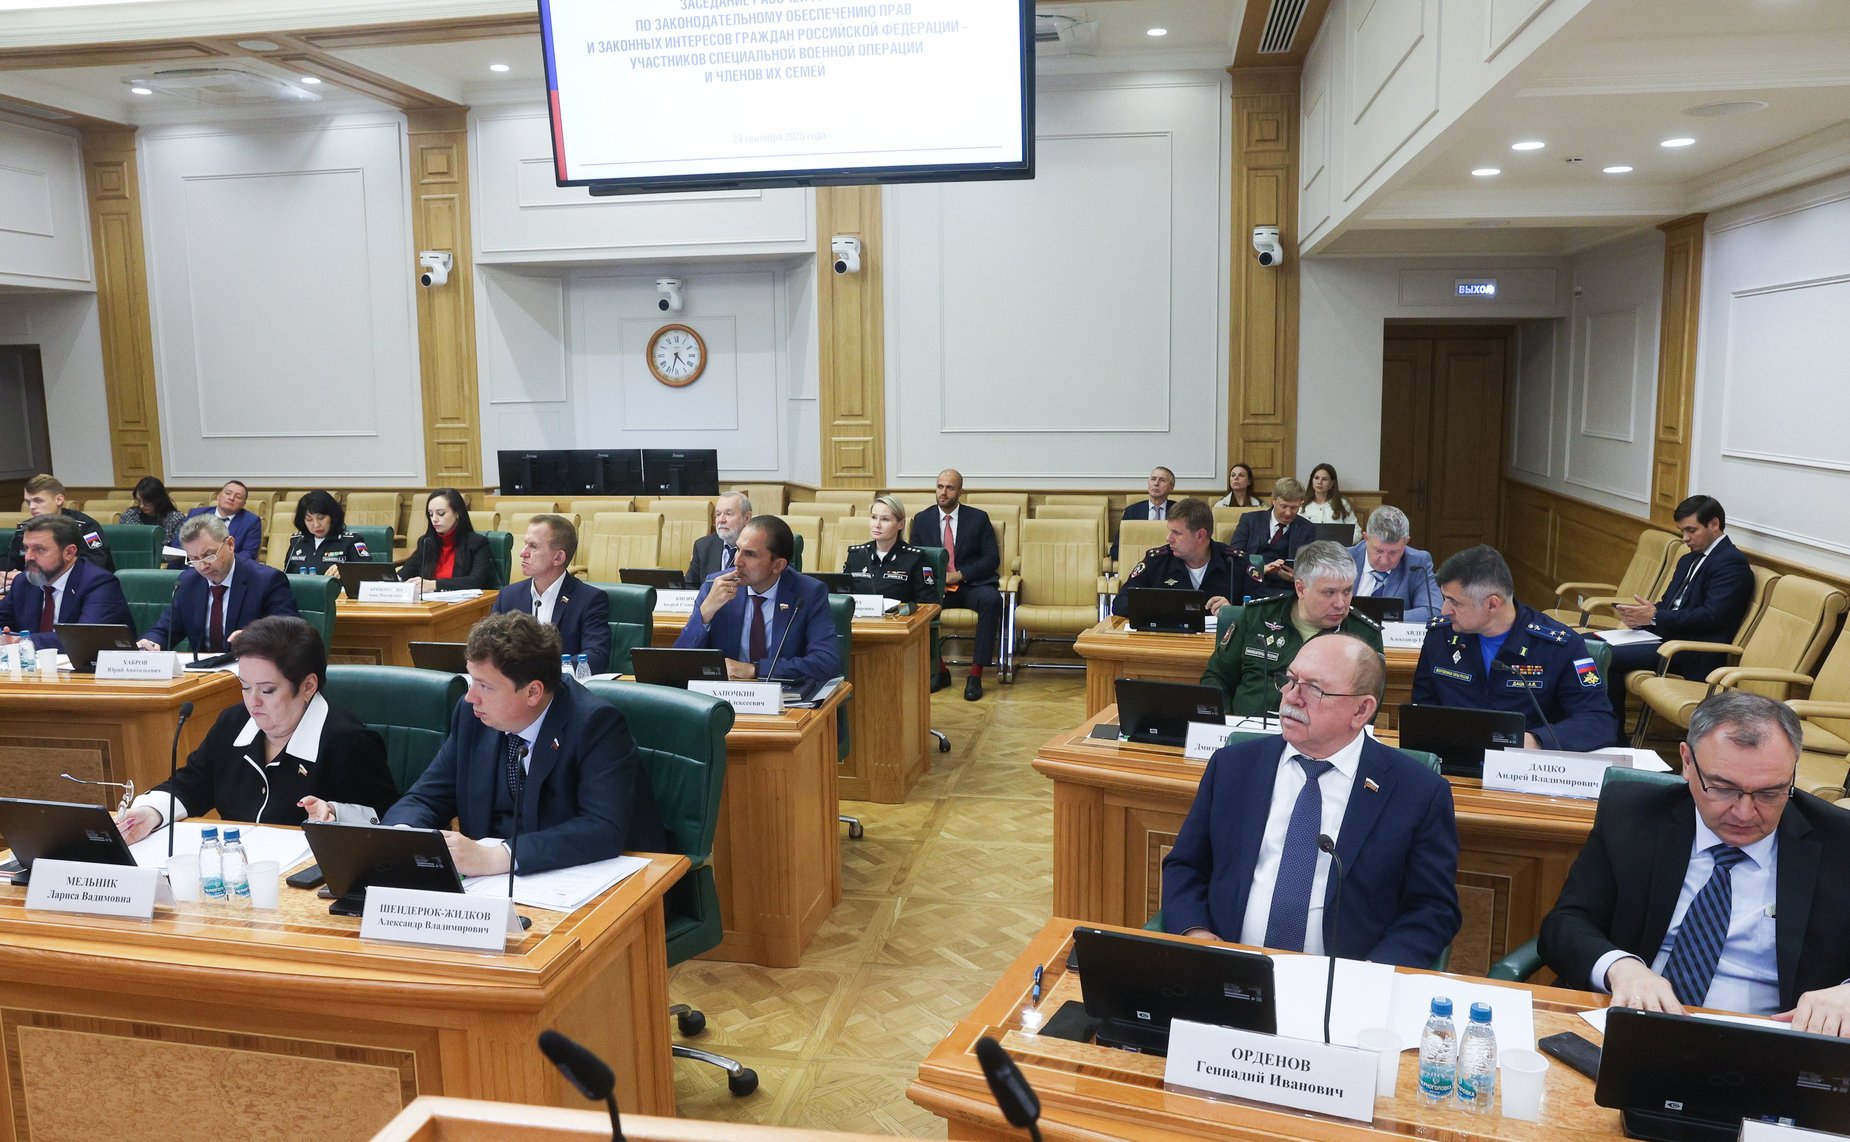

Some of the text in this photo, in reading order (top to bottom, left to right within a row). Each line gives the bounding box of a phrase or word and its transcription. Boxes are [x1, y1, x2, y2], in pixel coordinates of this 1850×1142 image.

[635, 4, 912, 32] ПО ЗАКОНОДАТЕЛЬНОМУ ОБЕСПЕЧЕНИЮ ПРАВ
[586, 41, 595, 54] И
[598, 36, 662, 54] ЗАКОННЫХ
[665, 32, 732, 49] ИНТЕРЕСОВ
[736, 29, 794, 45] ГРАЖДАН
[798, 24, 879, 40] РОССИЙСКОЙ
[882, 20, 960, 37] ФЕДЕРАЦИИ
[630, 40, 924, 70] УЧАСТНИКОВ СПЕЦИАЛЬНОЙ ВОЕННОЙ ОПЕРАЦИИ
[704, 62, 826, 84] И ЧЛЕНОВ ИХ СЕМЕЙ
[744, 134, 782, 144] сентября
[806, 132, 826, 141] года
[1528, 763, 1566, 774] ДАЦКО
[1496, 772, 1599, 788] Андрей Владимирович
[66, 876, 118, 890] МЕЛЬНИК
[47, 890, 132, 904] Лариса Вадимовна
[379, 904, 491, 922] ШЕНДЕРЮК-ЖИДКОВ
[378, 918, 490, 934] Александр Владимирович
[1231, 1047, 1312, 1072] ОРДЕНОВ
[1196, 1060, 1344, 1099] Геннадий Иванович
